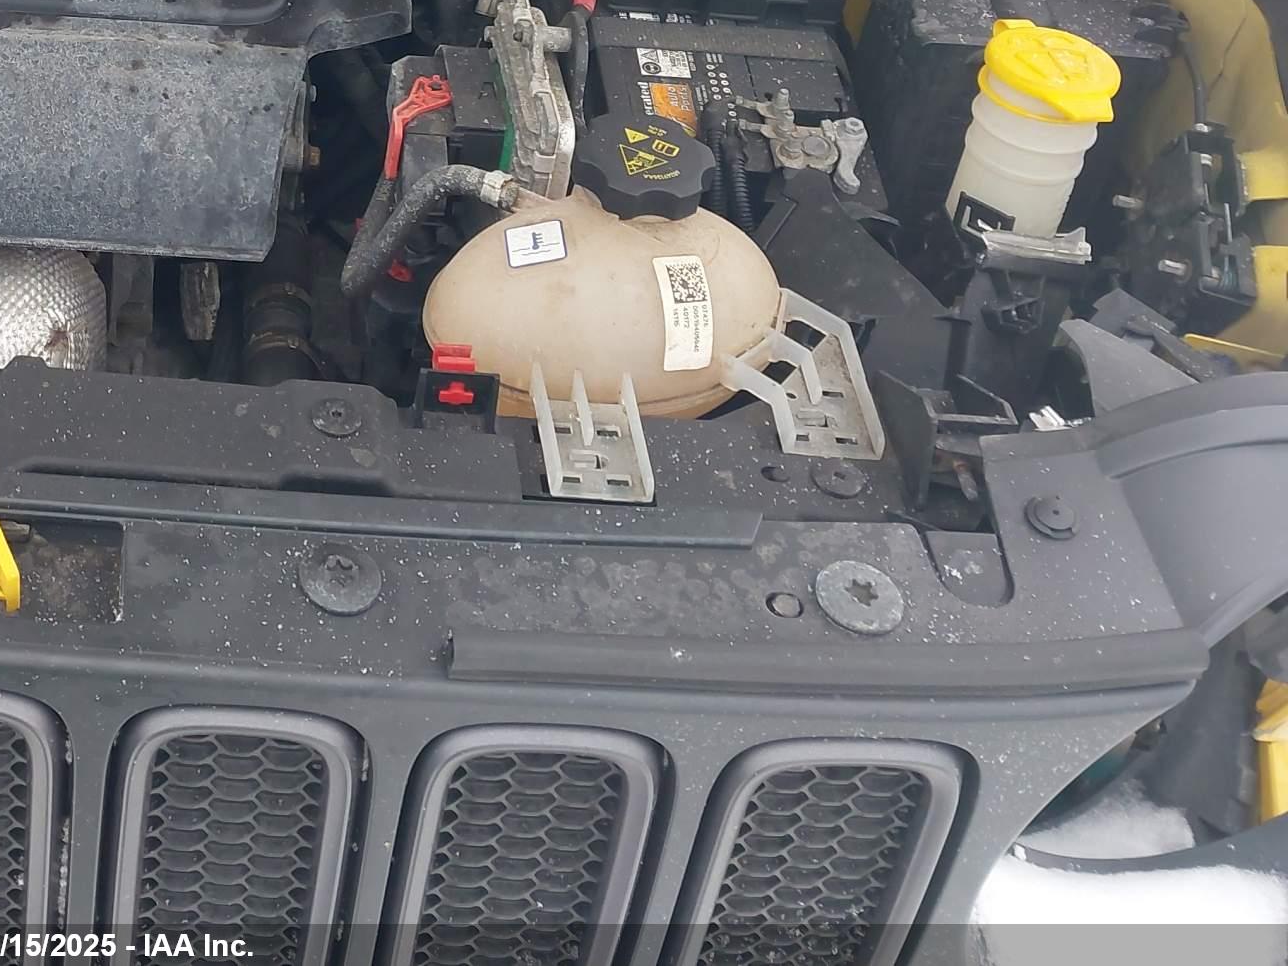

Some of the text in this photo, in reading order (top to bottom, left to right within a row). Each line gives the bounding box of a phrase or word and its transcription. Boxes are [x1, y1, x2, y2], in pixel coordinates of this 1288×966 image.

[637, 81, 654, 115] erated
[667, 86, 679, 107] Auto
[681, 87, 691, 111] Parts
